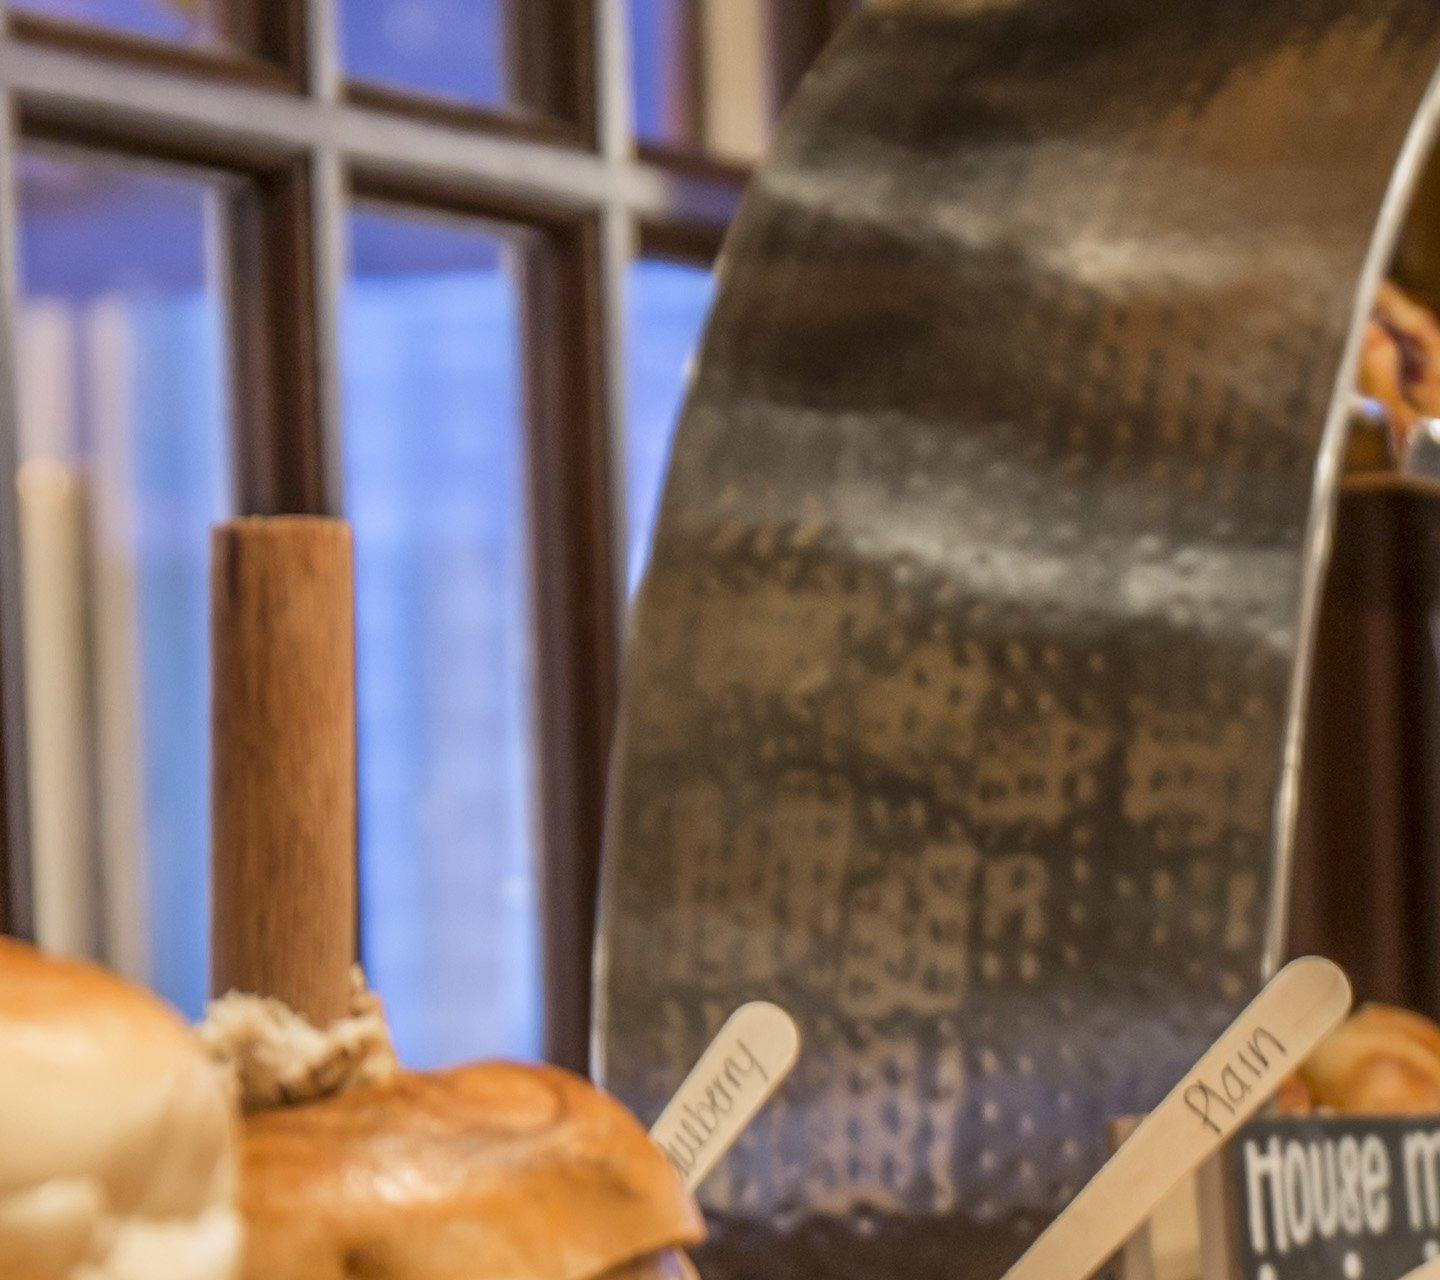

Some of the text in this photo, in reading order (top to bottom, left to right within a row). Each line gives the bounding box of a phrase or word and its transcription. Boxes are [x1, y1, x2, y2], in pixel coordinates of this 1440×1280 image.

[657, 1038, 769, 1179] lueberry
[1183, 1026, 1288, 1134] Plain
[1245, 1133, 1392, 1255] House
